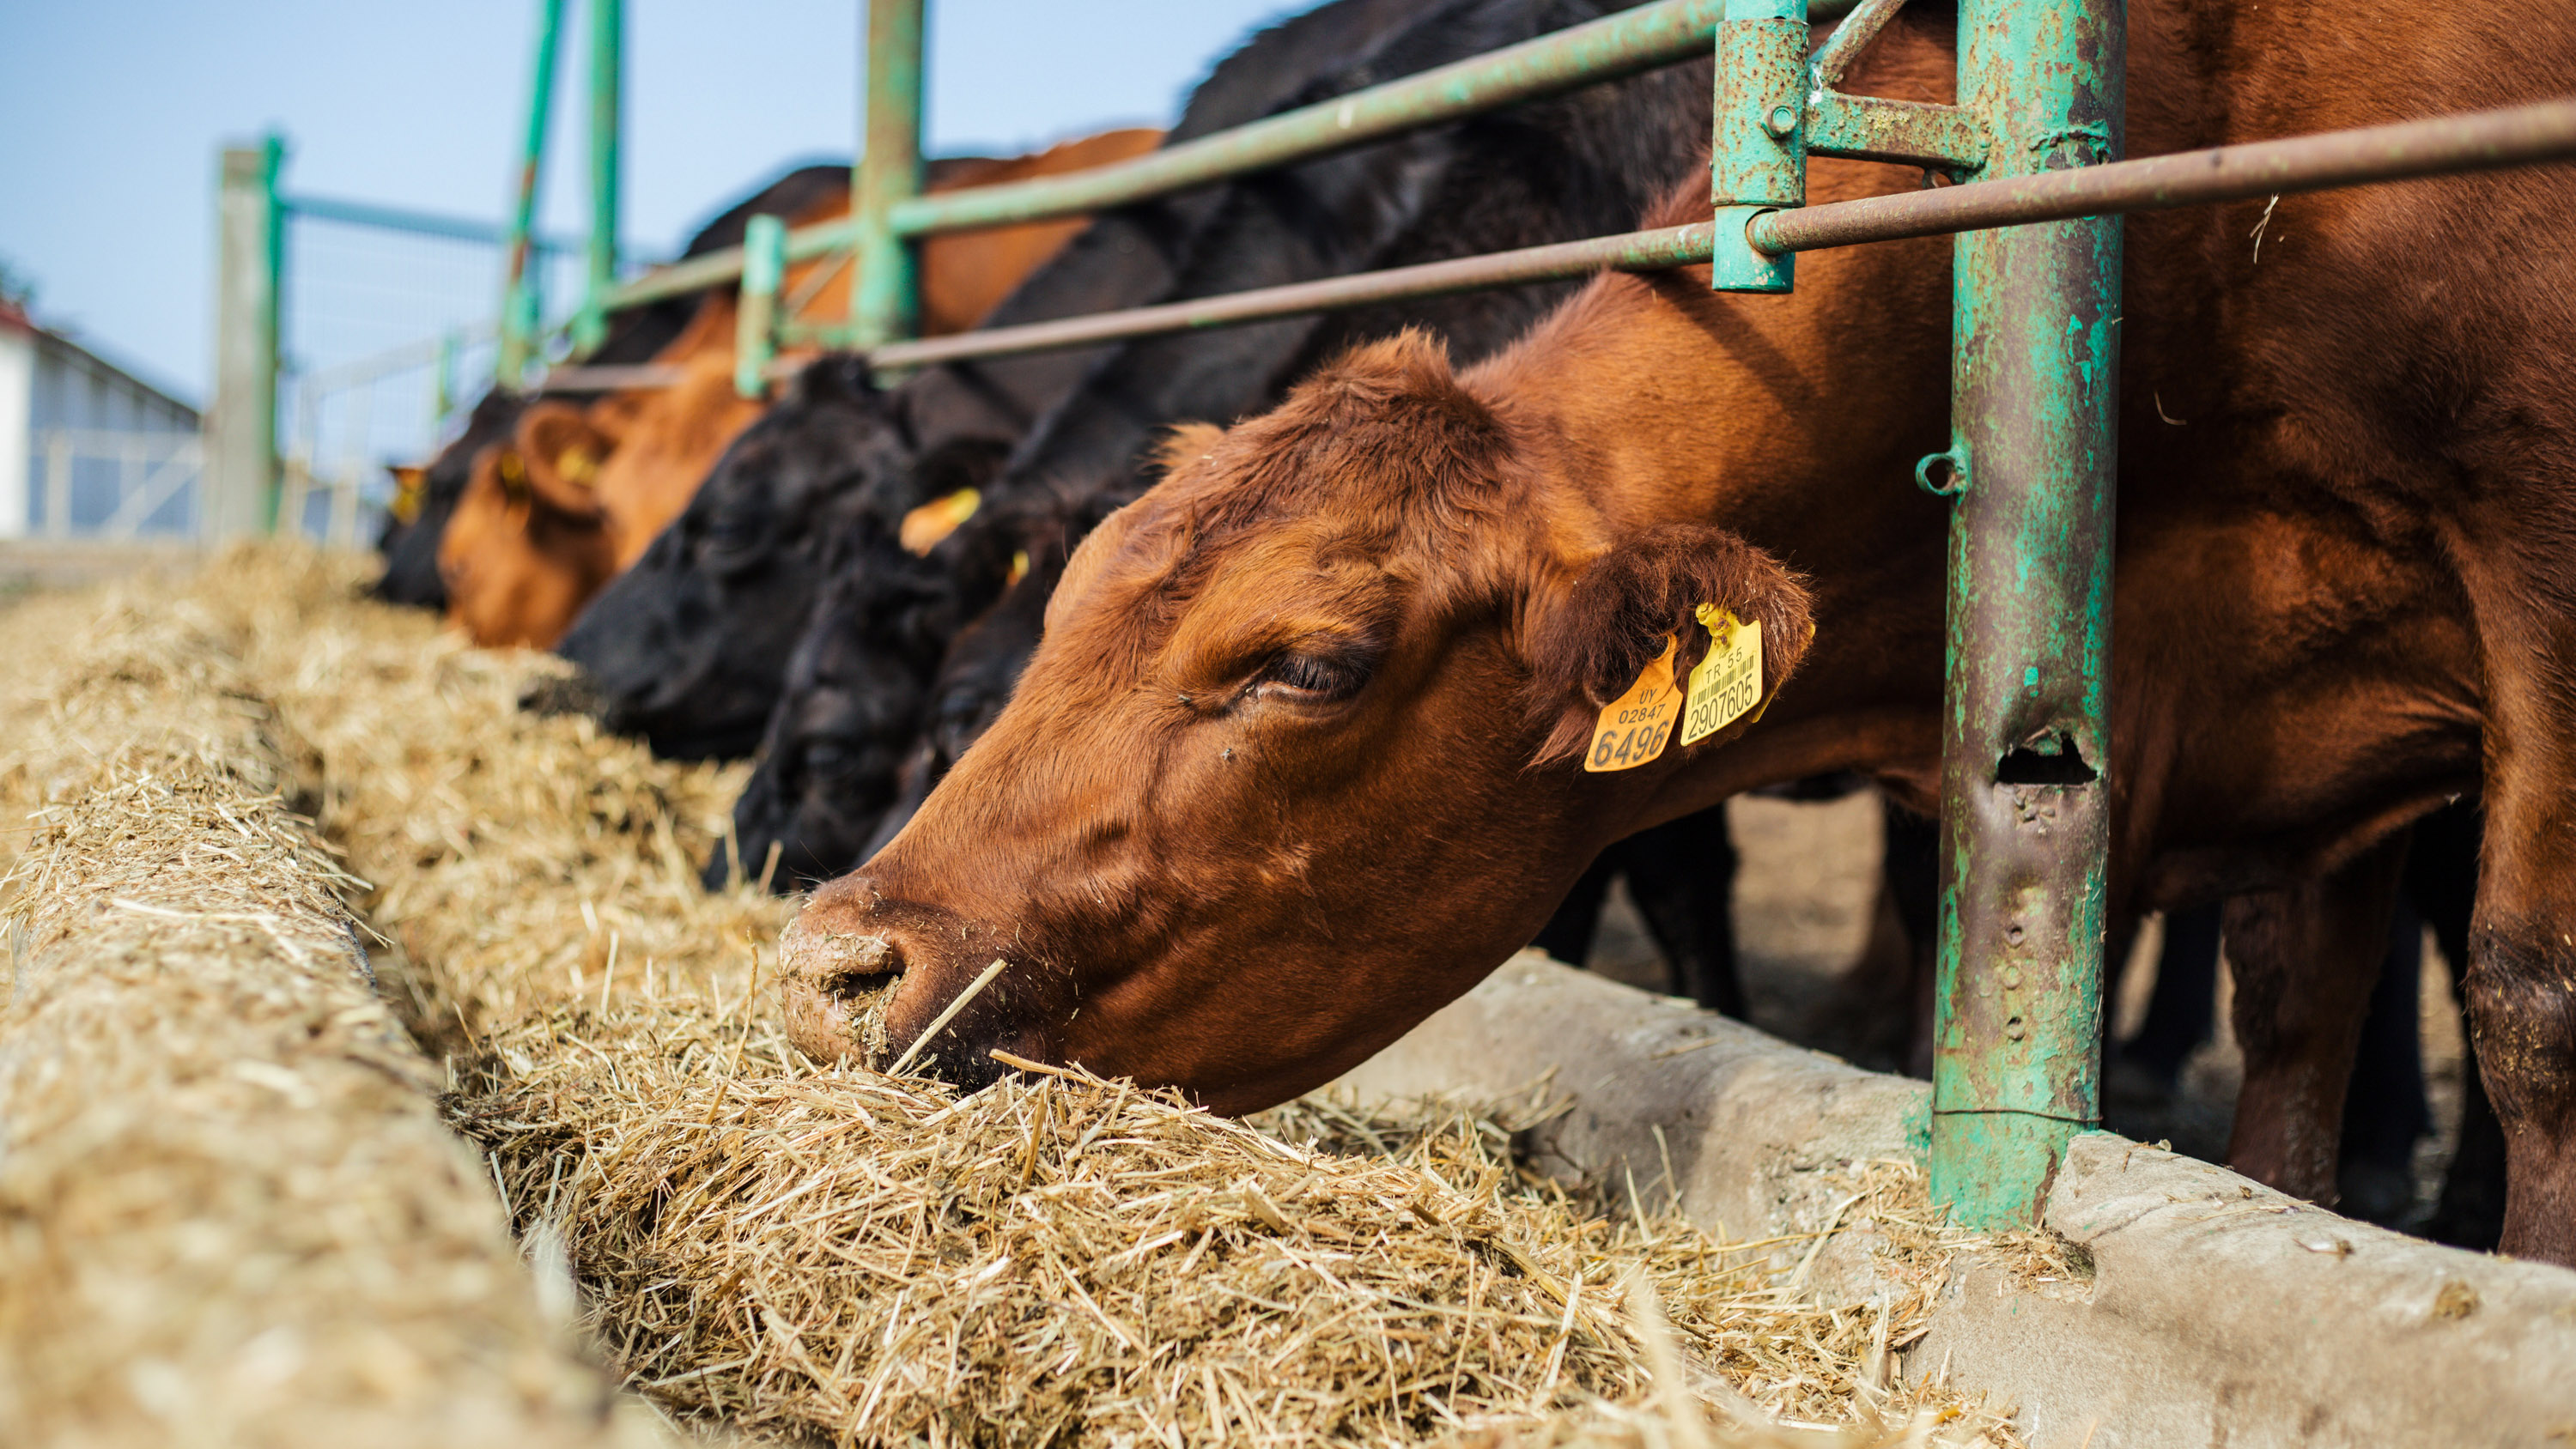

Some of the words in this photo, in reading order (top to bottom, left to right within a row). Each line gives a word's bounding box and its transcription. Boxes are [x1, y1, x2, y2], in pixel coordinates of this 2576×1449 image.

[1705, 666, 1721, 684] TR
[1728, 646, 1742, 669] 55
[1619, 704, 1666, 724] 02847
[1639, 688, 1657, 705] UY
[1687, 674, 1753, 740] 2907605
[1594, 720, 1669, 767] 6496
